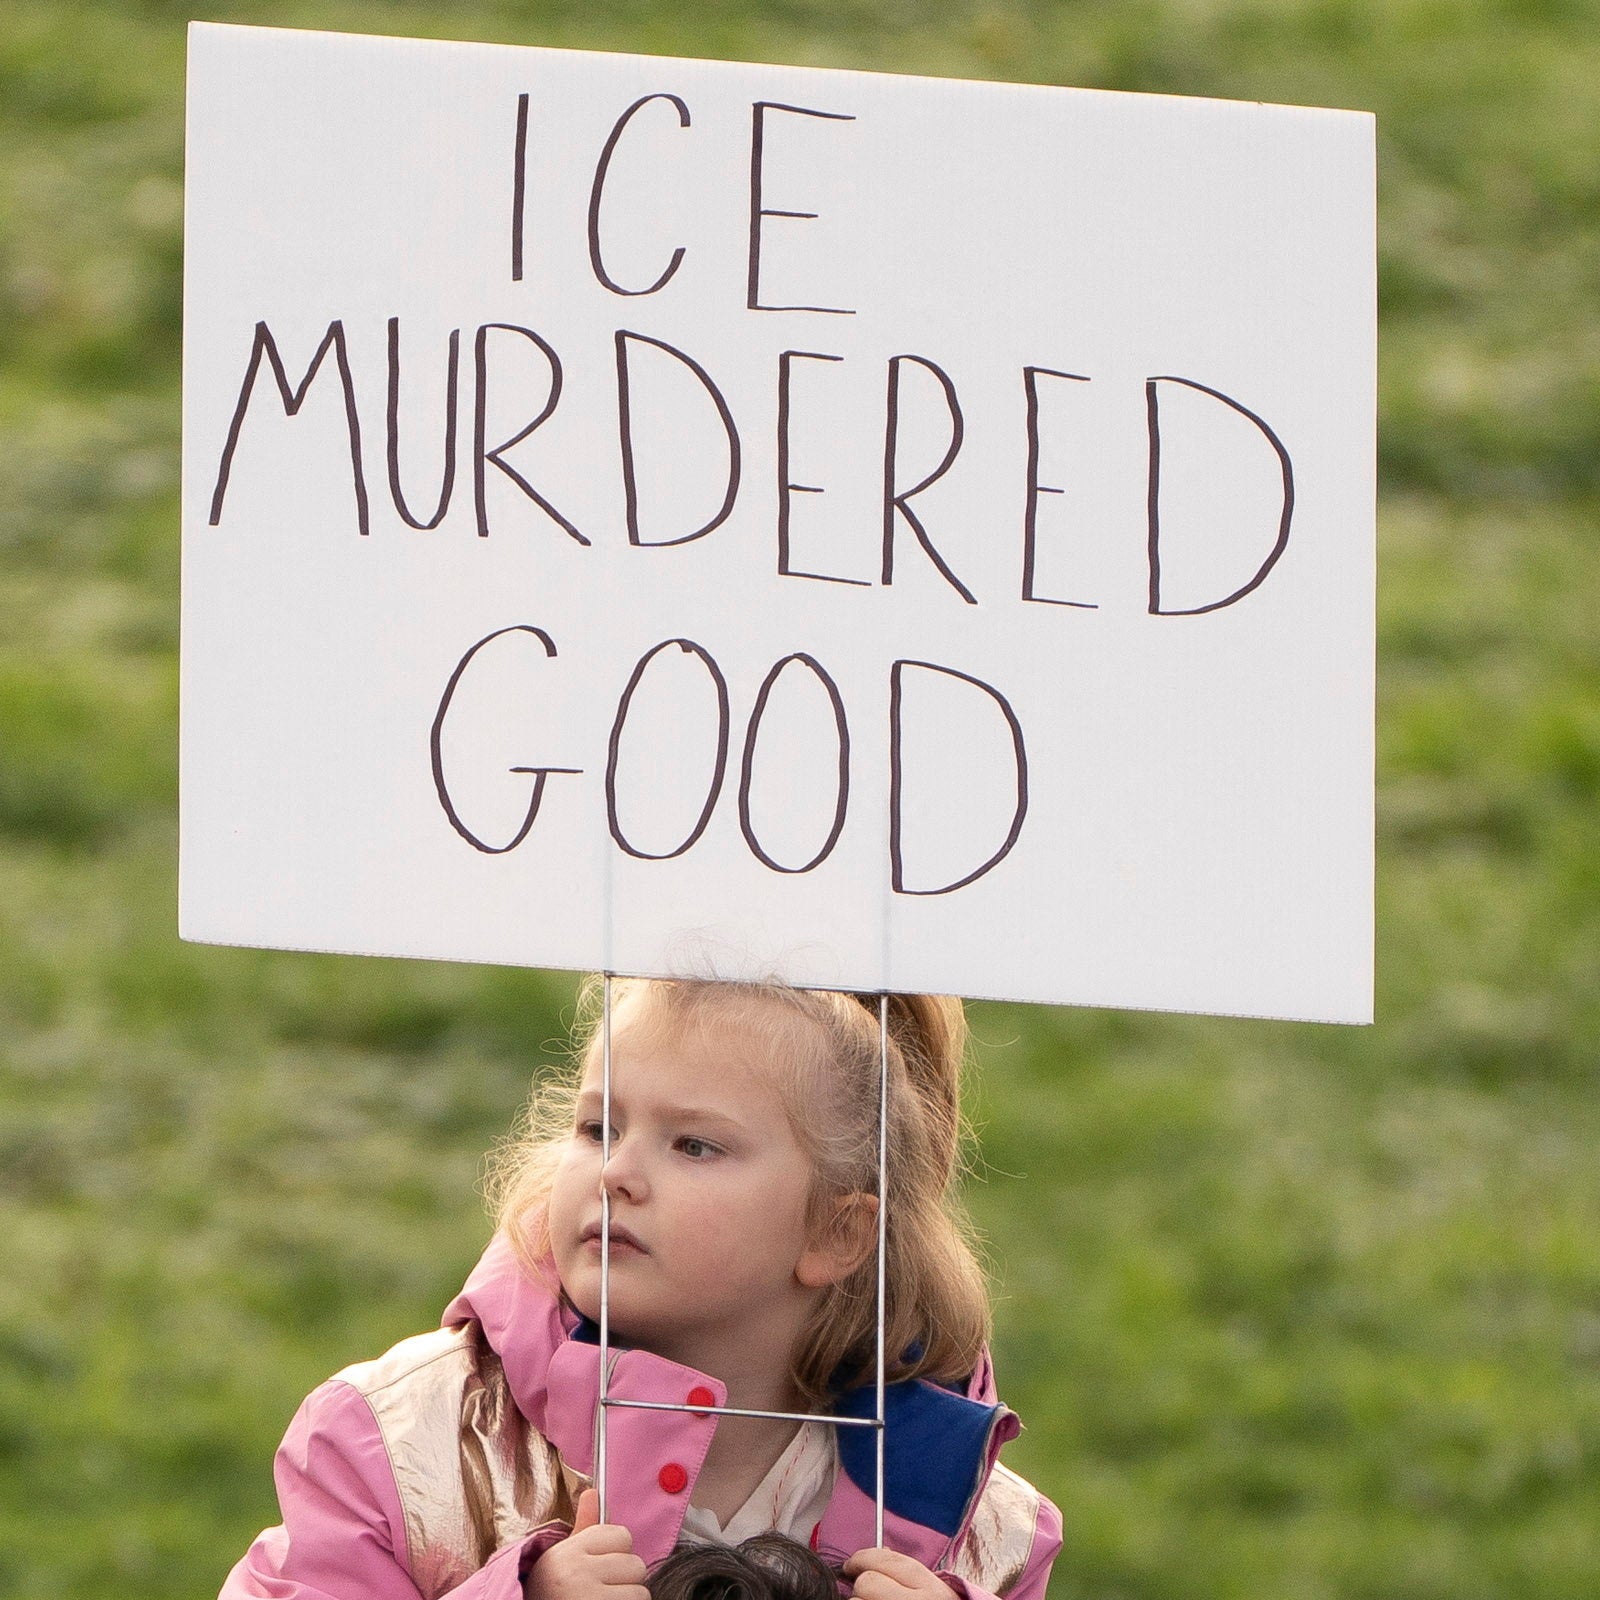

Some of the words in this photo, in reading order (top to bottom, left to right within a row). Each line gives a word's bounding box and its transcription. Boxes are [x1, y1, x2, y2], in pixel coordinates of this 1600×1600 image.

[512, 92, 856, 314] ICE
[209, 316, 1294, 616] MURDERED
[431, 625, 1028, 896] GOOD
